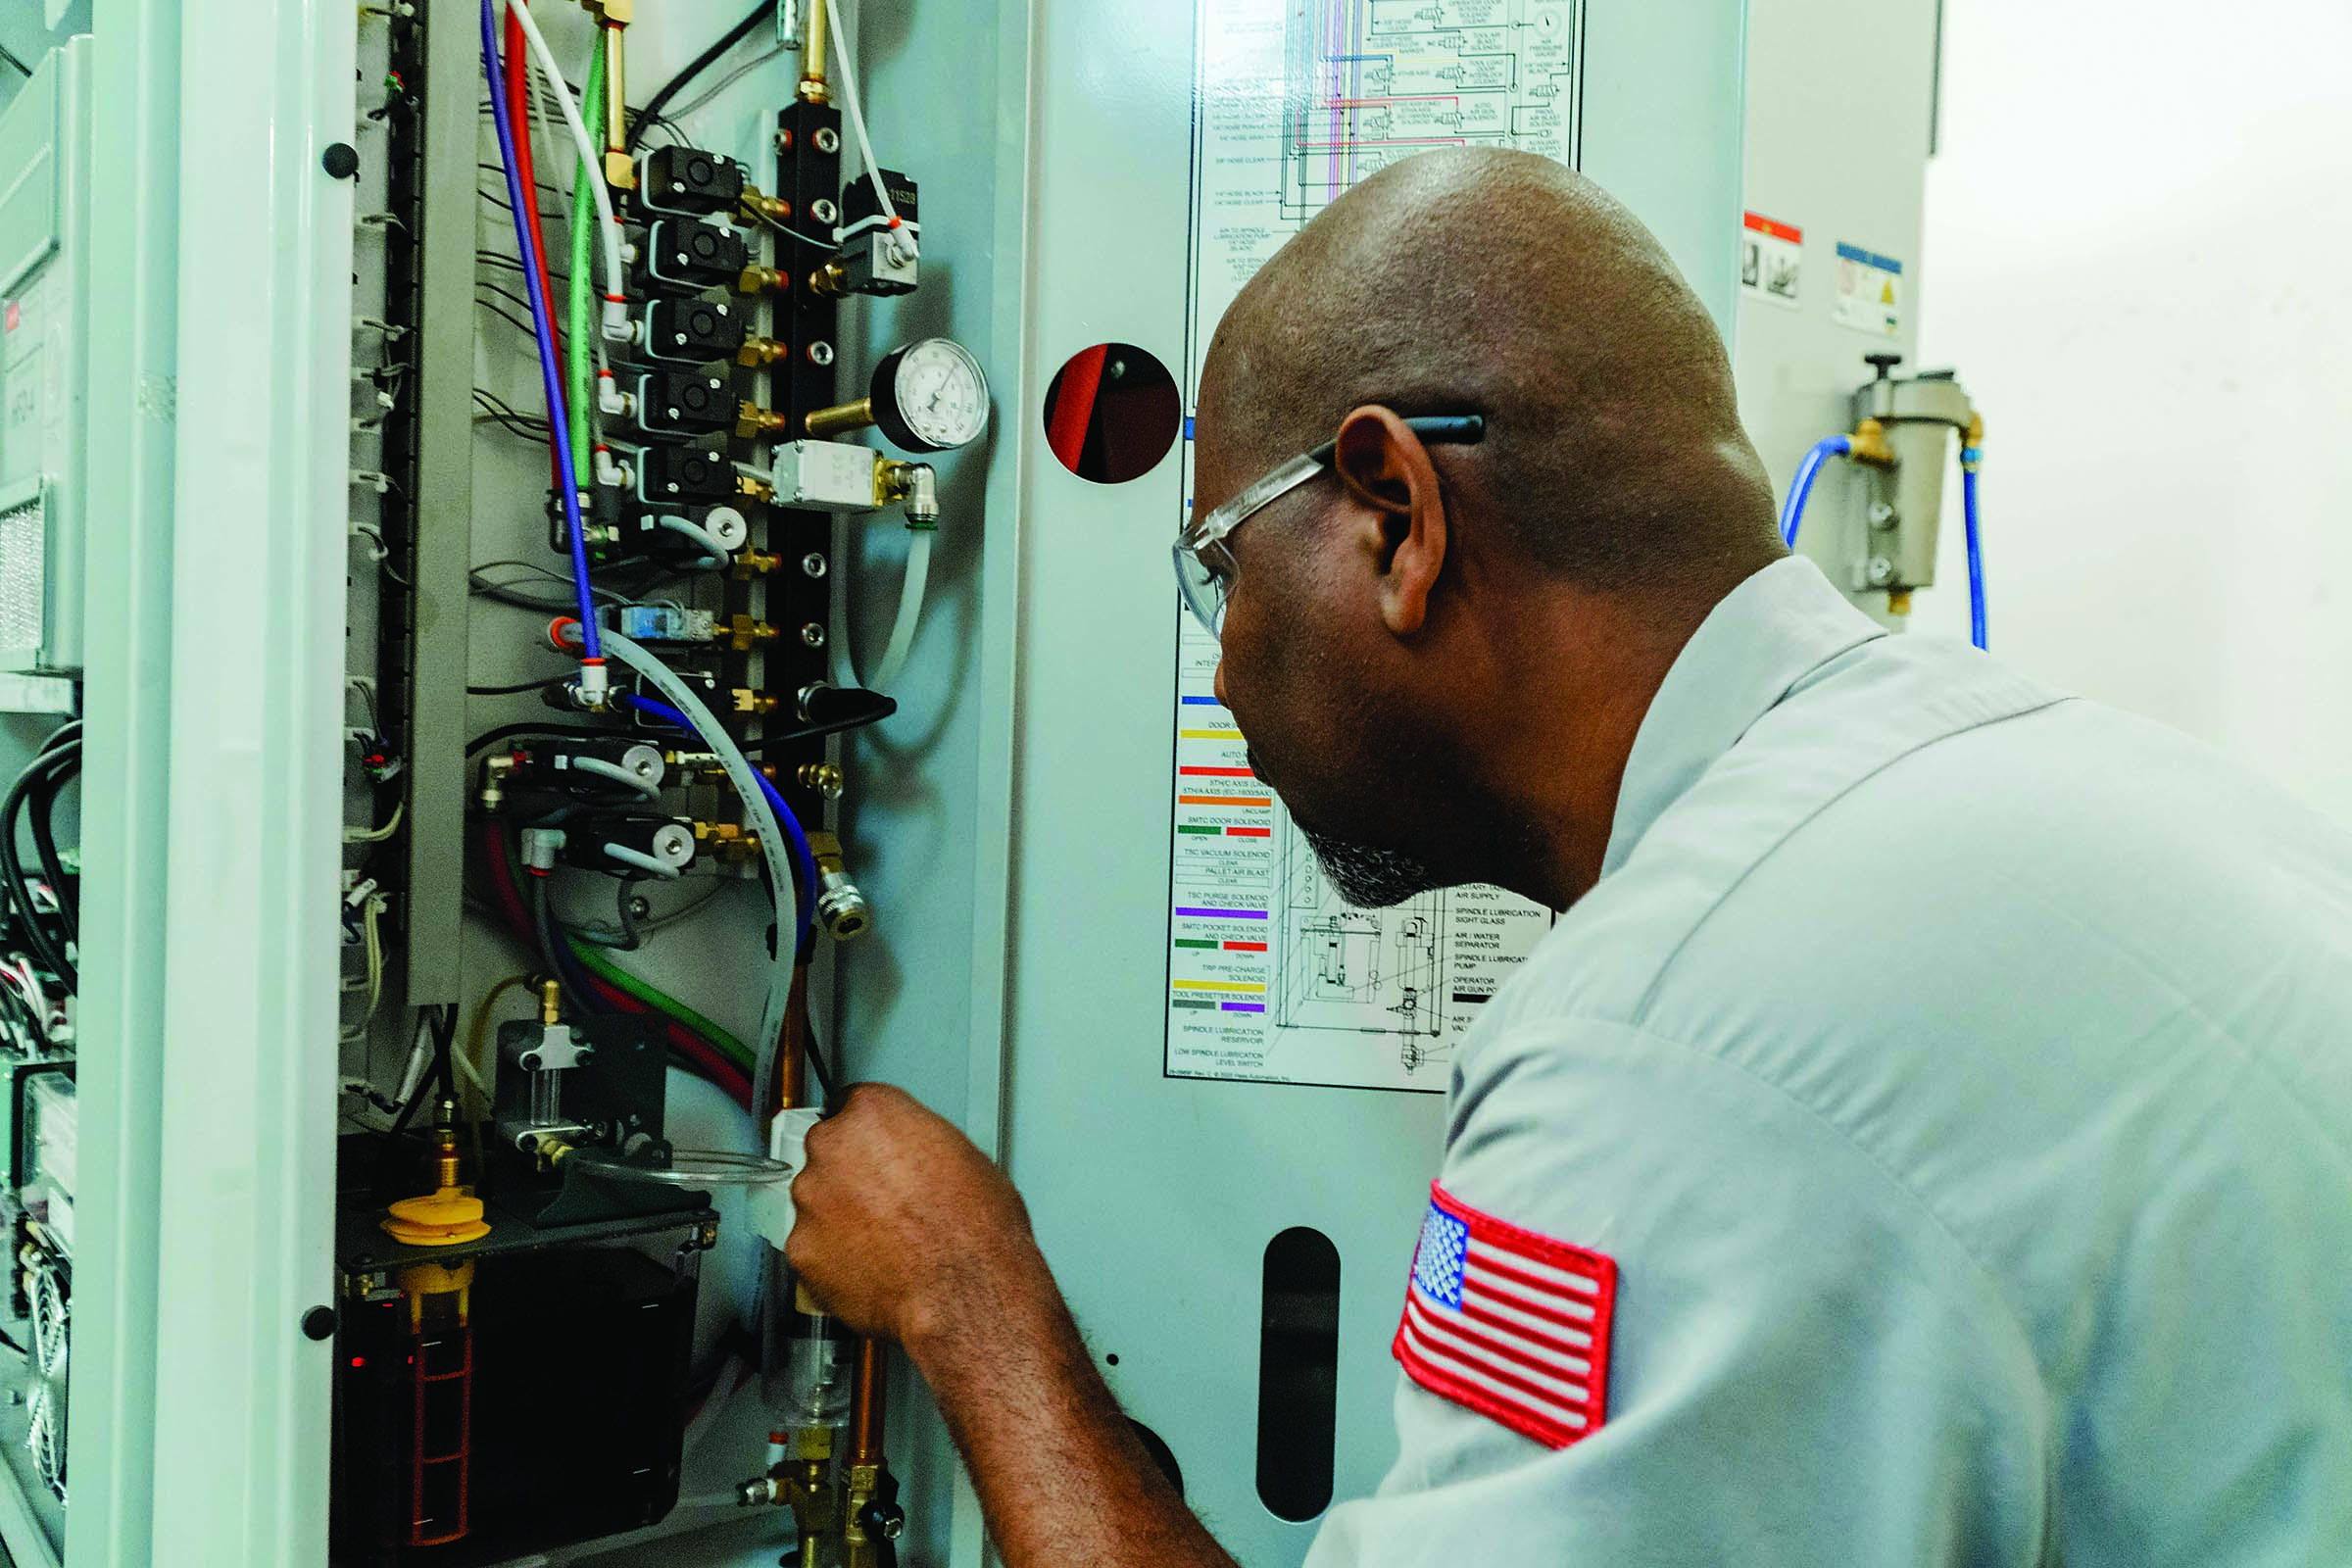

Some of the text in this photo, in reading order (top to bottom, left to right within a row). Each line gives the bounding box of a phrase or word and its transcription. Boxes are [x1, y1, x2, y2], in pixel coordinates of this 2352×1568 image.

[1233, 850, 1271, 858] SOLENOID
[1490, 908, 1541, 917] LUBRICATION
[1218, 964, 1266, 973] PRE-CHARGE
[1452, 976, 1494, 985] OPERATOR
[1215, 1027, 1263, 1036] LUBRICATION
[1215, 1058, 1235, 1067] LEVEL
